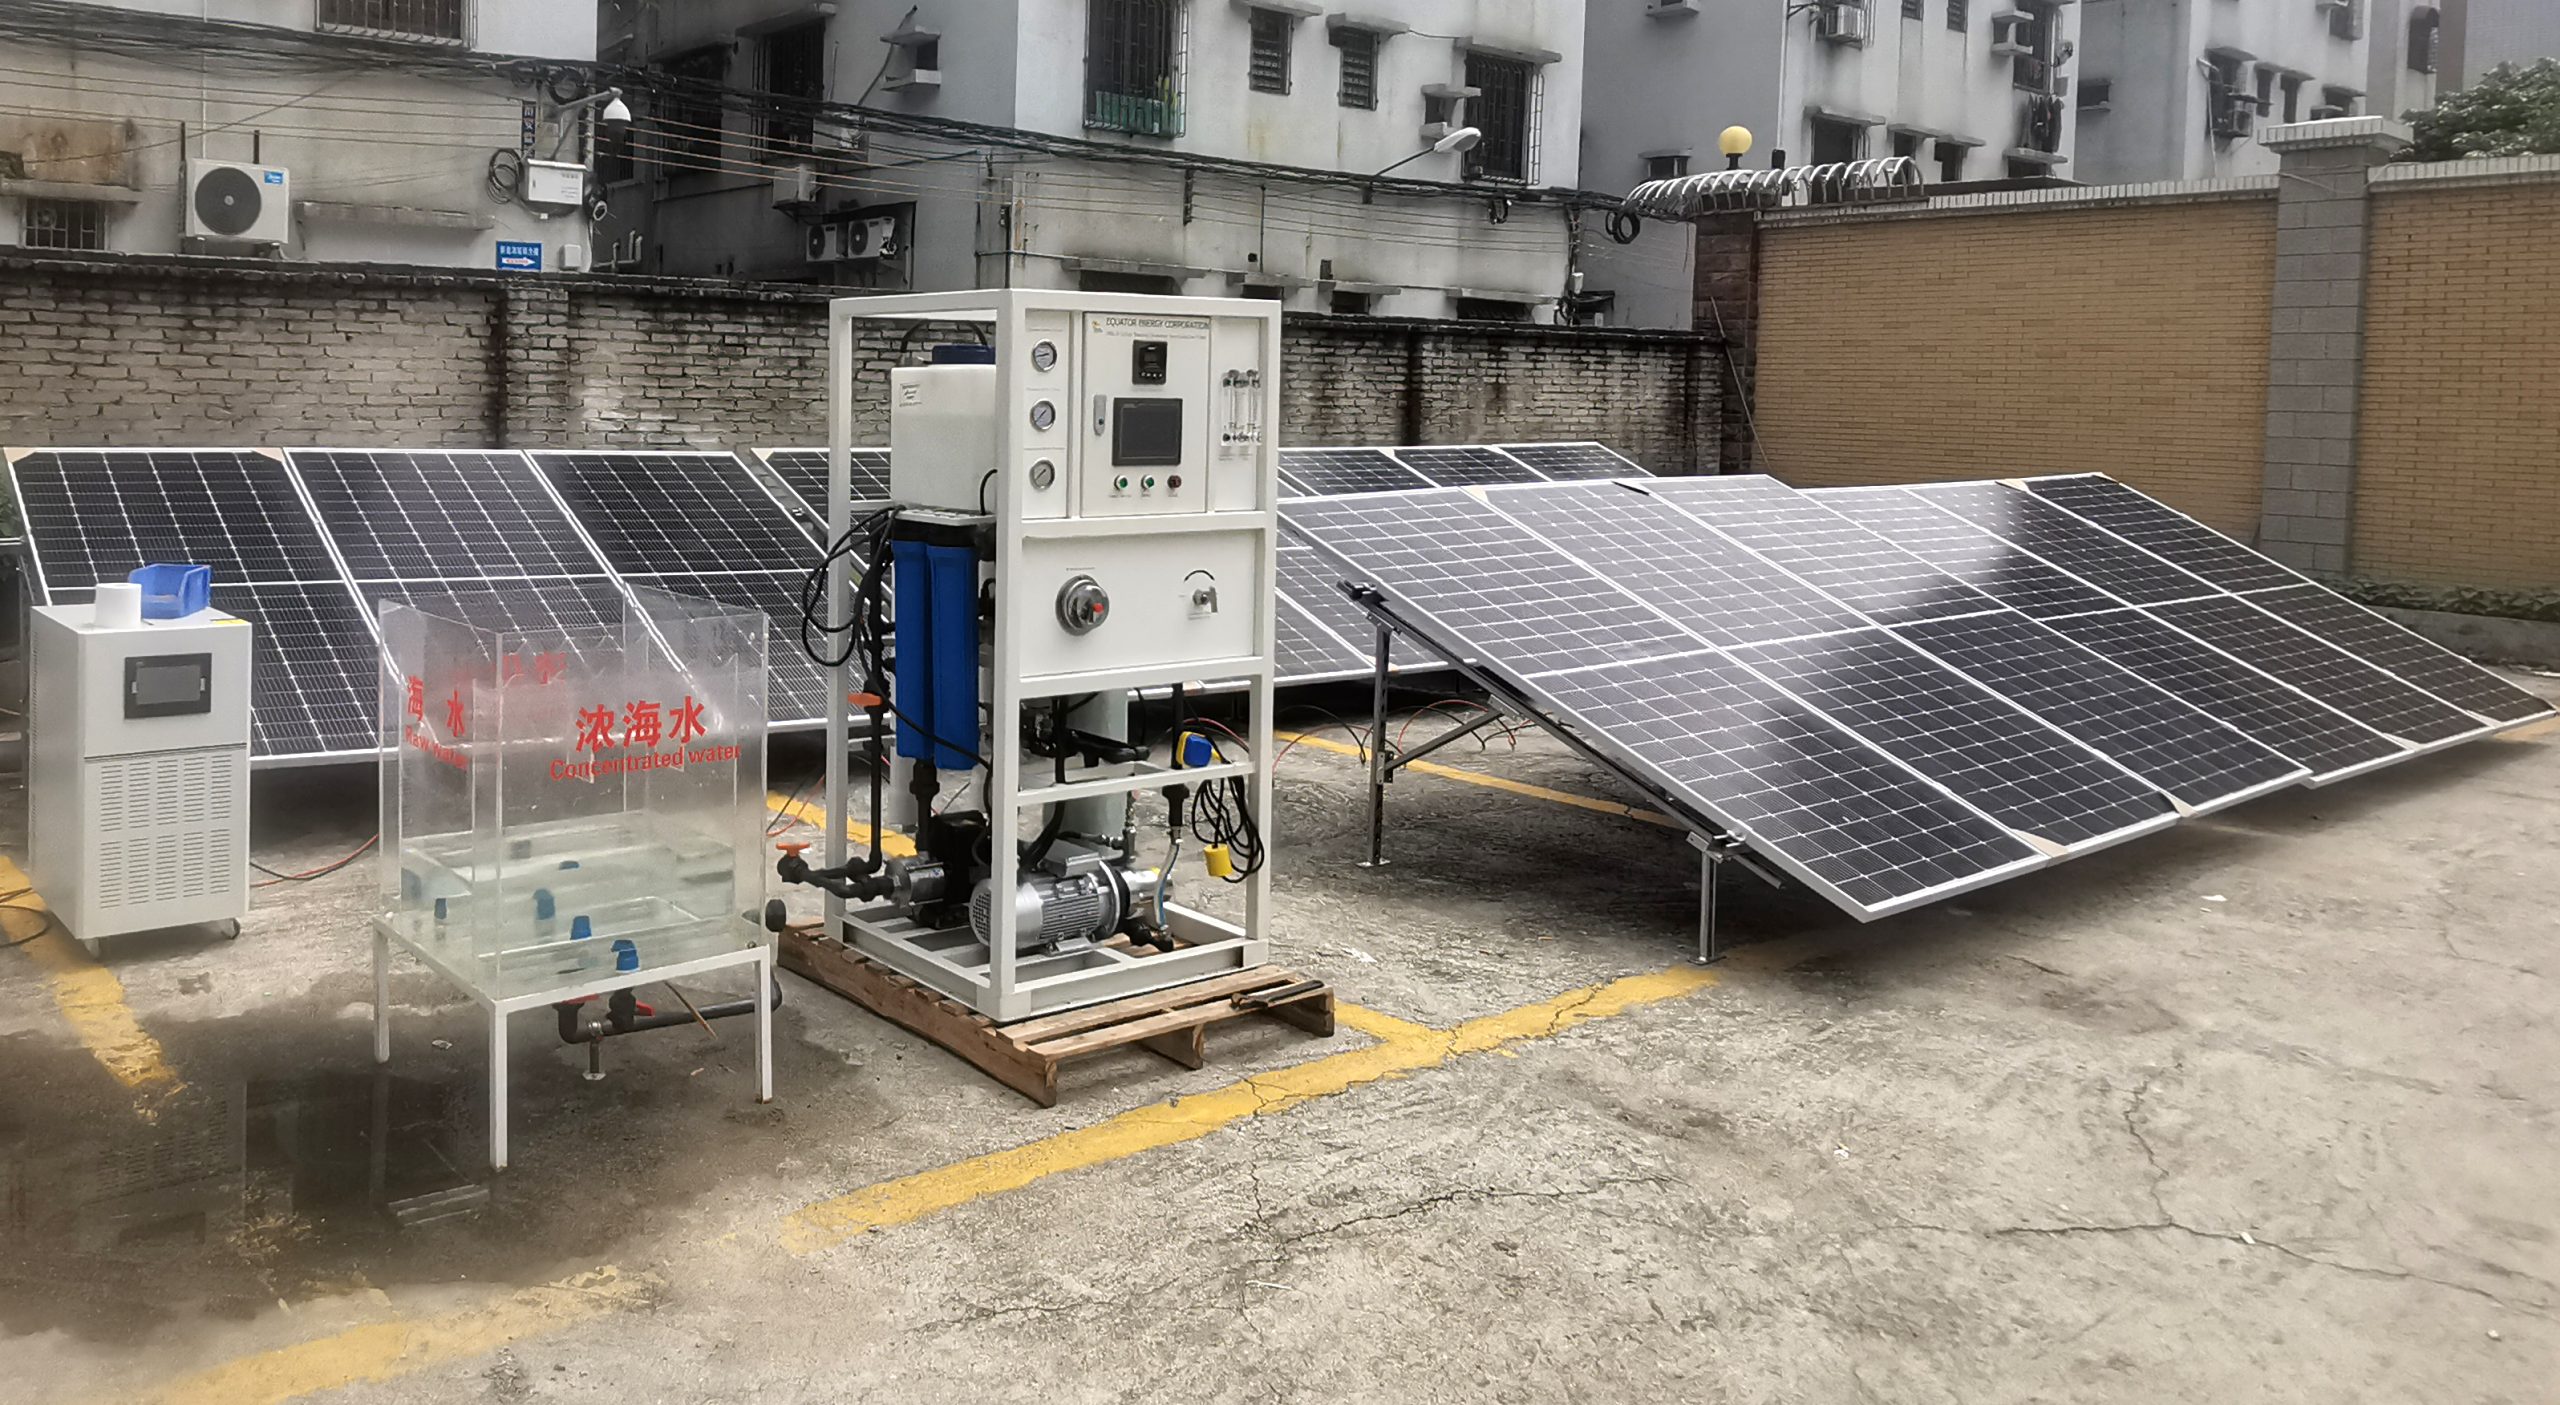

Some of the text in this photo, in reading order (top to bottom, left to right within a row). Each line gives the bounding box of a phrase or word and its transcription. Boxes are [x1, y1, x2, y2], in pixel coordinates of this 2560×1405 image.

[1105, 317, 1137, 328] EQUATOR
[1138, 319, 1164, 328] ENERGY
[405, 724, 430, 754] Raw
[575, 695, 706, 753] 浓海水
[550, 744, 741, 781] Concentrated water
